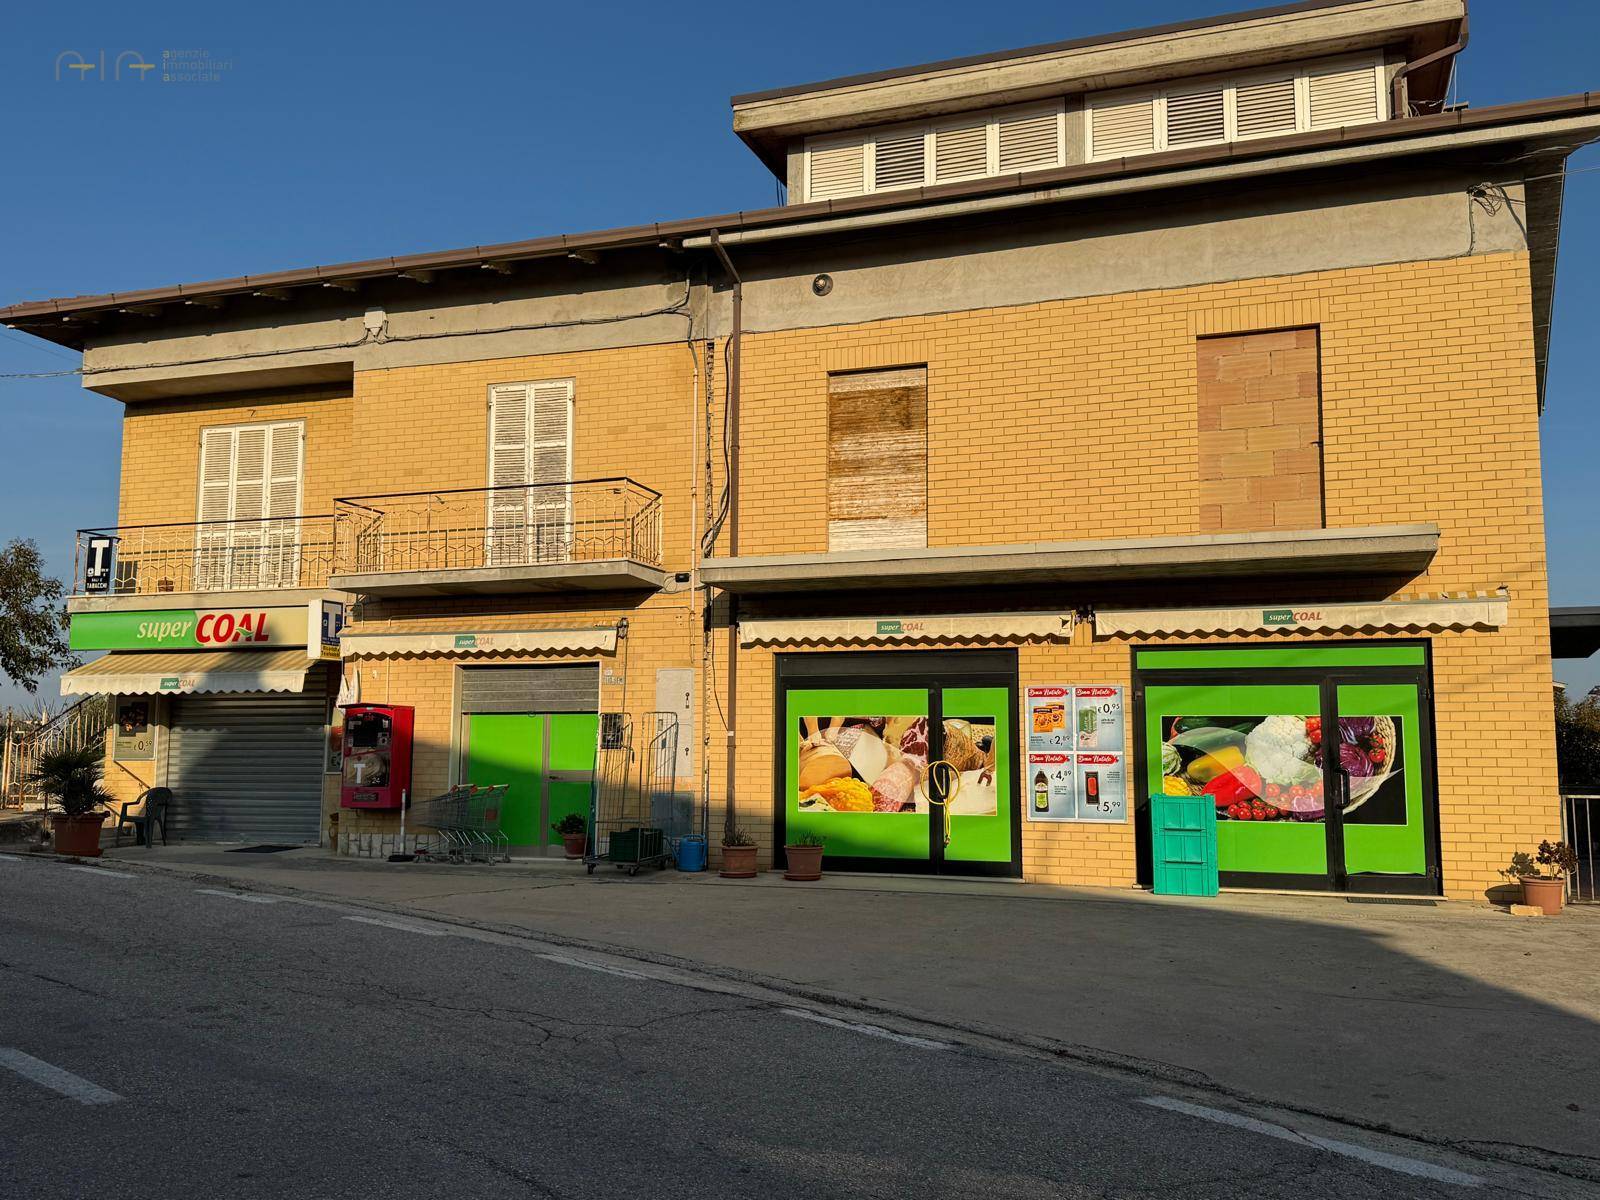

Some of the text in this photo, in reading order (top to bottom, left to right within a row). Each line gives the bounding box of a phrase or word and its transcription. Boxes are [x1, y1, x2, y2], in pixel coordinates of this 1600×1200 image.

[91, 540, 109, 576] T
[902, 622, 925, 631] COAL
[1293, 612, 1322, 621] COAL
[137, 613, 269, 643] super COAL
[354, 764, 366, 784] T
